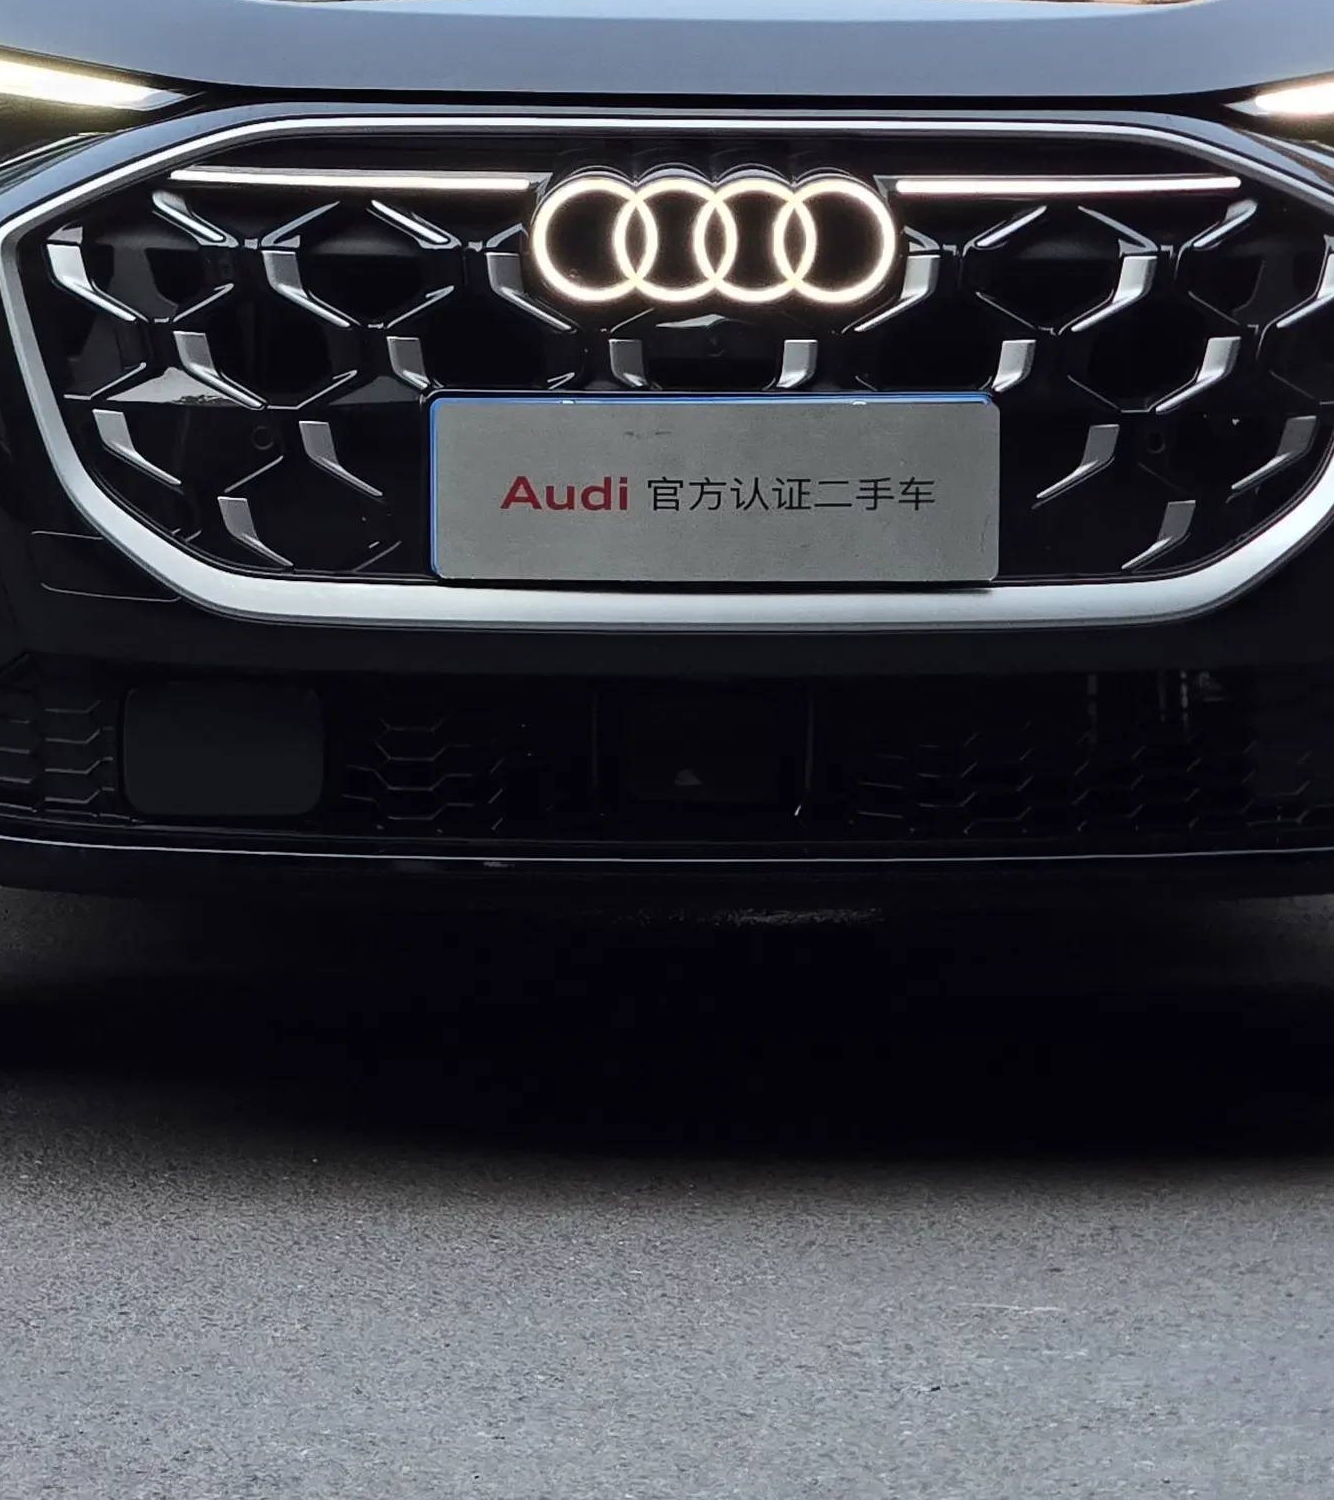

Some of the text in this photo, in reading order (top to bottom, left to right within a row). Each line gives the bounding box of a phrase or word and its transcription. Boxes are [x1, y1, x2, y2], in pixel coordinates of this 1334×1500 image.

[499, 475, 937, 512] Audi 官方认证二手车
